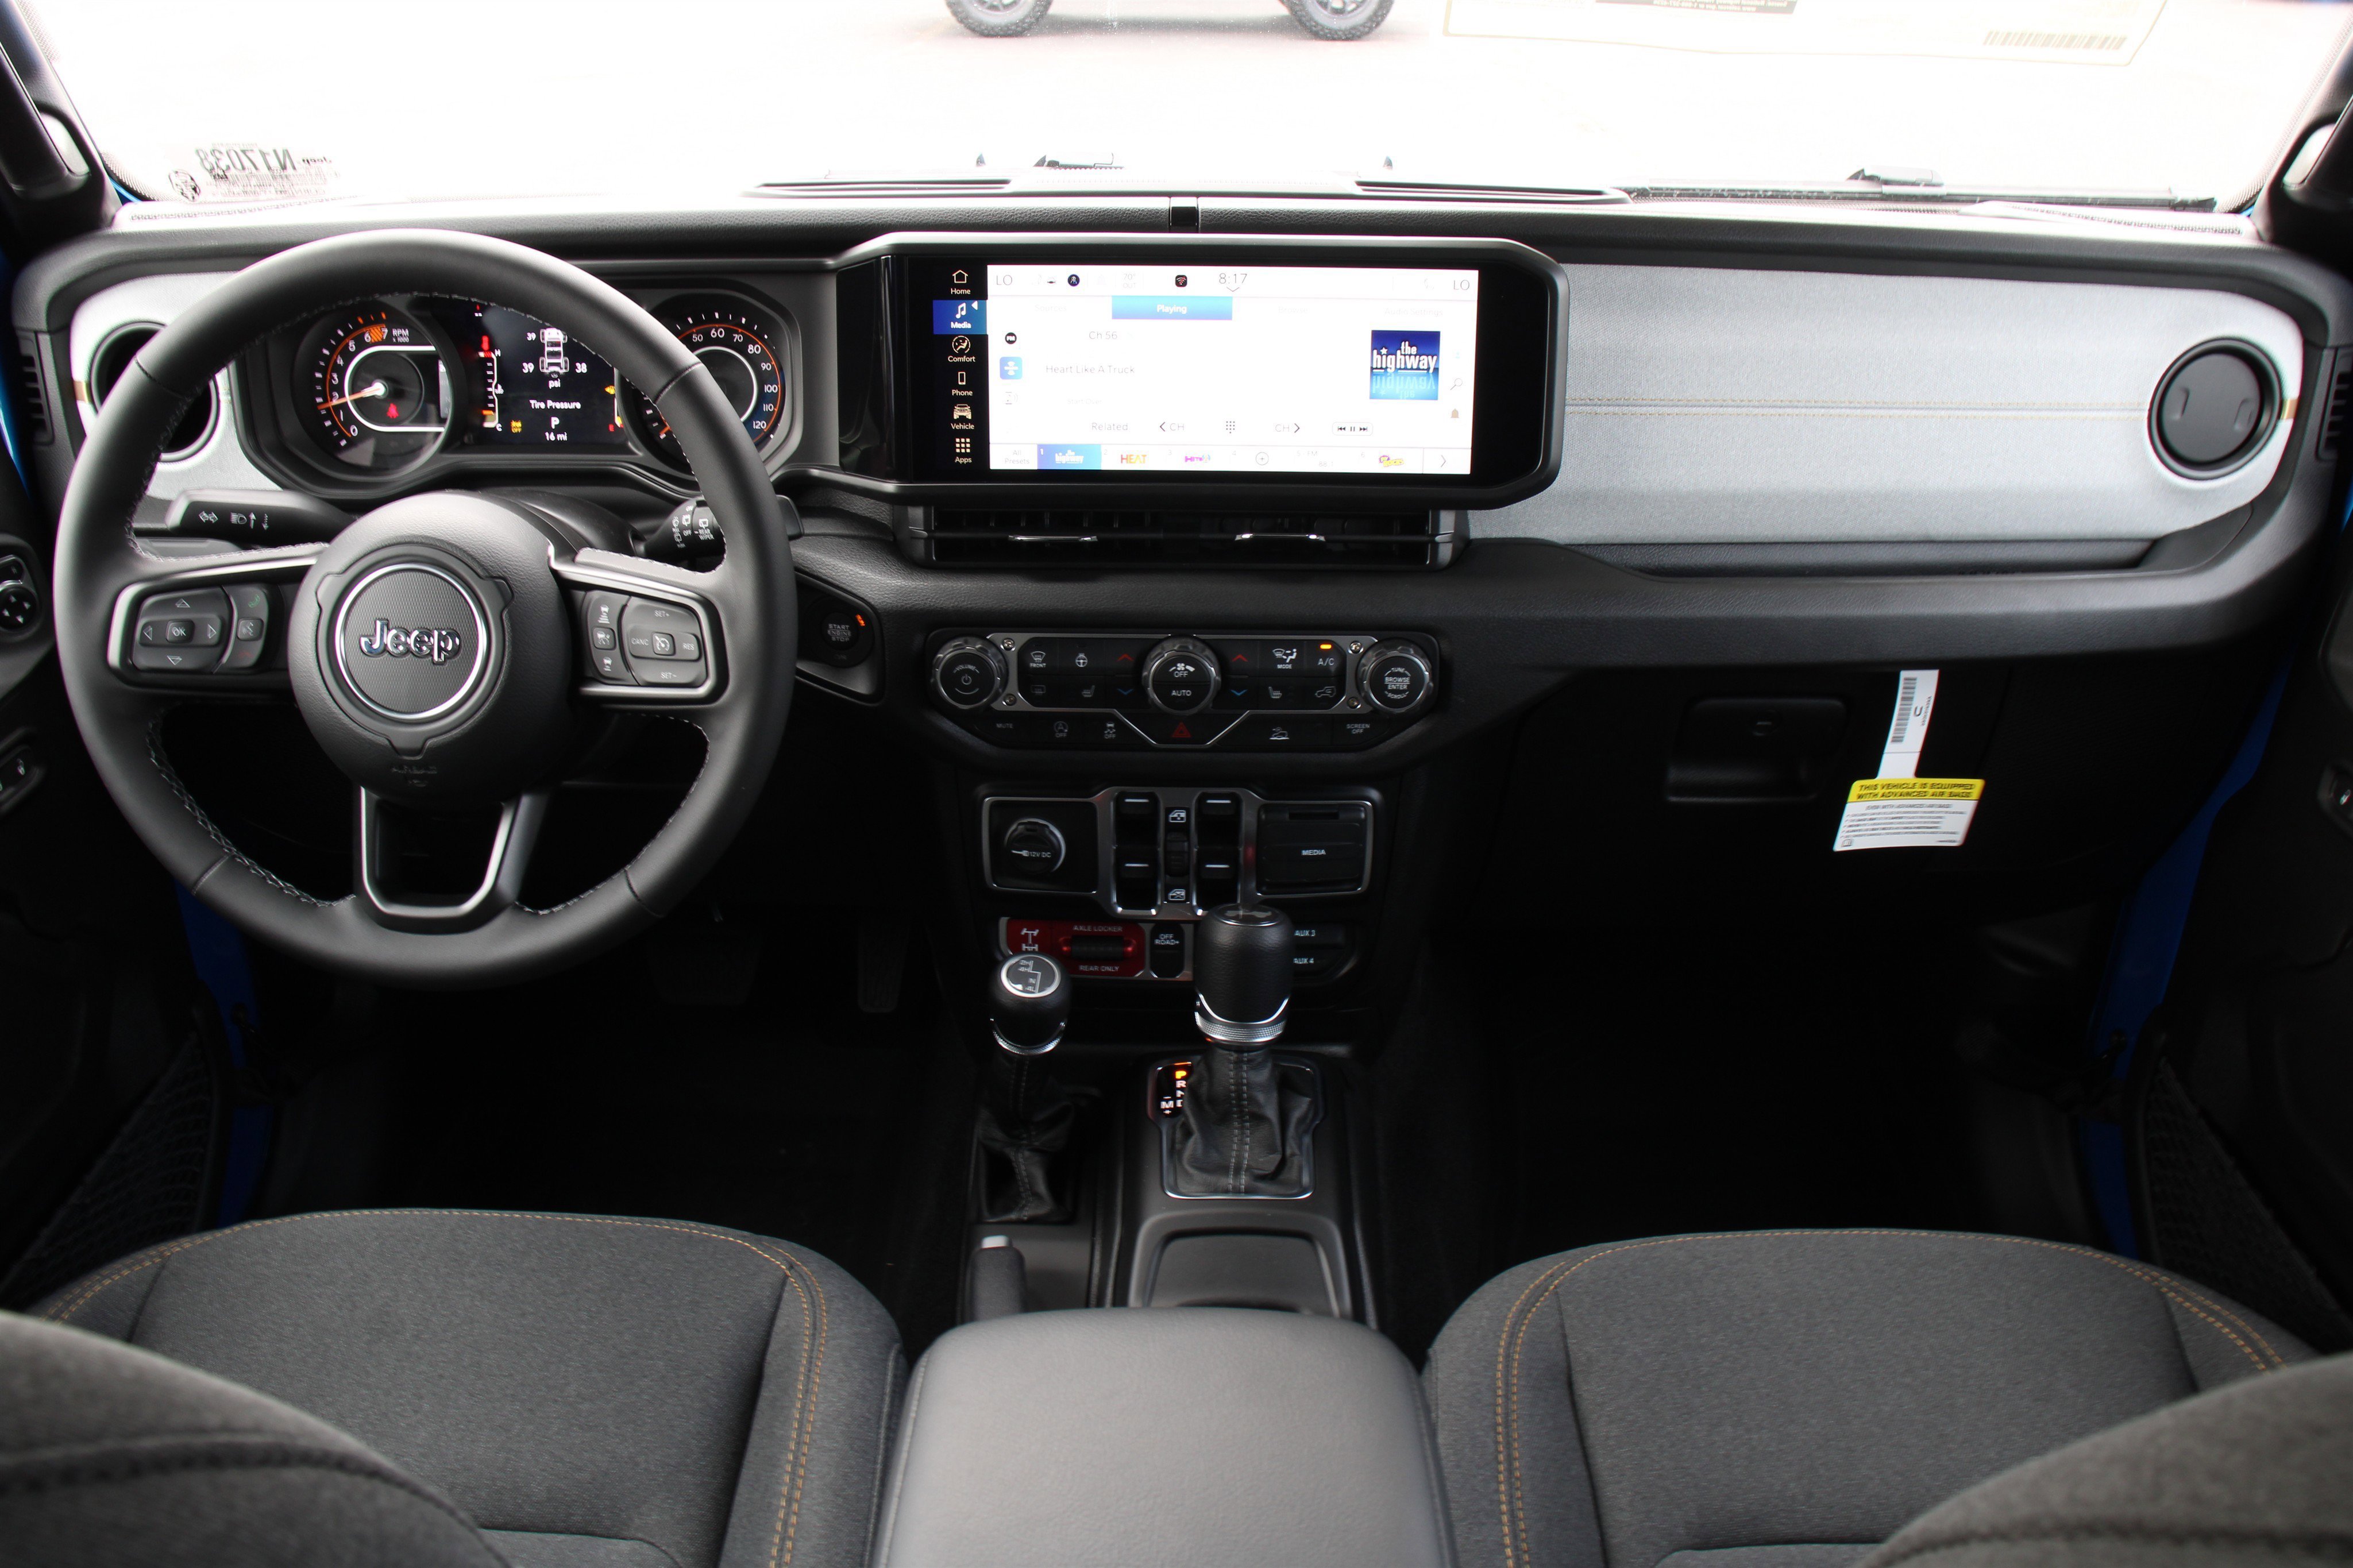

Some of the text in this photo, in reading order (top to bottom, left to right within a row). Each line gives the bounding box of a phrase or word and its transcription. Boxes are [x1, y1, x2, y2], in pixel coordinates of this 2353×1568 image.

[996, 275, 1013, 286] LO
[1218, 273, 1248, 285] 8:17
[1453, 280, 1470, 291] LO
[1157, 304, 1187, 314] Playing
[364, 328, 388, 342] 6 7
[392, 329, 409, 337] RPM
[527, 333, 536, 341] 39
[710, 328, 725, 338] 60
[1089, 331, 1118, 339] Ch 56
[692, 334, 703, 342] 50
[732, 334, 743, 342] 70
[348, 340, 356, 352] 5
[747, 344, 761, 354] 80
[1401, 341, 1417, 355] the
[1372, 347, 1437, 373] highway
[522, 362, 534, 373] 39
[575, 362, 587, 373] 38
[761, 362, 772, 371] 90
[1046, 365, 1135, 374] Heart Like A Truck
[549, 379, 561, 389] psi
[764, 384, 778, 393] 100
[529, 400, 581, 409] Tire Pressure
[763, 403, 774, 412] 110
[550, 417, 560, 429] P
[753, 420, 767, 430] 120
[1091, 422, 1129, 431] Related
[1170, 423, 1185, 431] CH
[350, 425, 358, 437] 0
[1275, 424, 1290, 432] CH
[545, 432, 568, 441] 16 mi
[955, 456, 972, 464] Apps
[1120, 454, 1147, 464] HEAT
[172, 627, 187, 636] OK
[360, 619, 460, 665] Jeep
[682, 643, 695, 651] RES
[1318, 656, 1335, 667] A/C
[1858, 783, 1879, 791] THIS
[1881, 782, 1918, 790] VEHICLE
[1856, 791, 1879, 800] WITH
[1175, 1070, 1187, 1079] P
[1160, 1100, 1174, 1109] M
